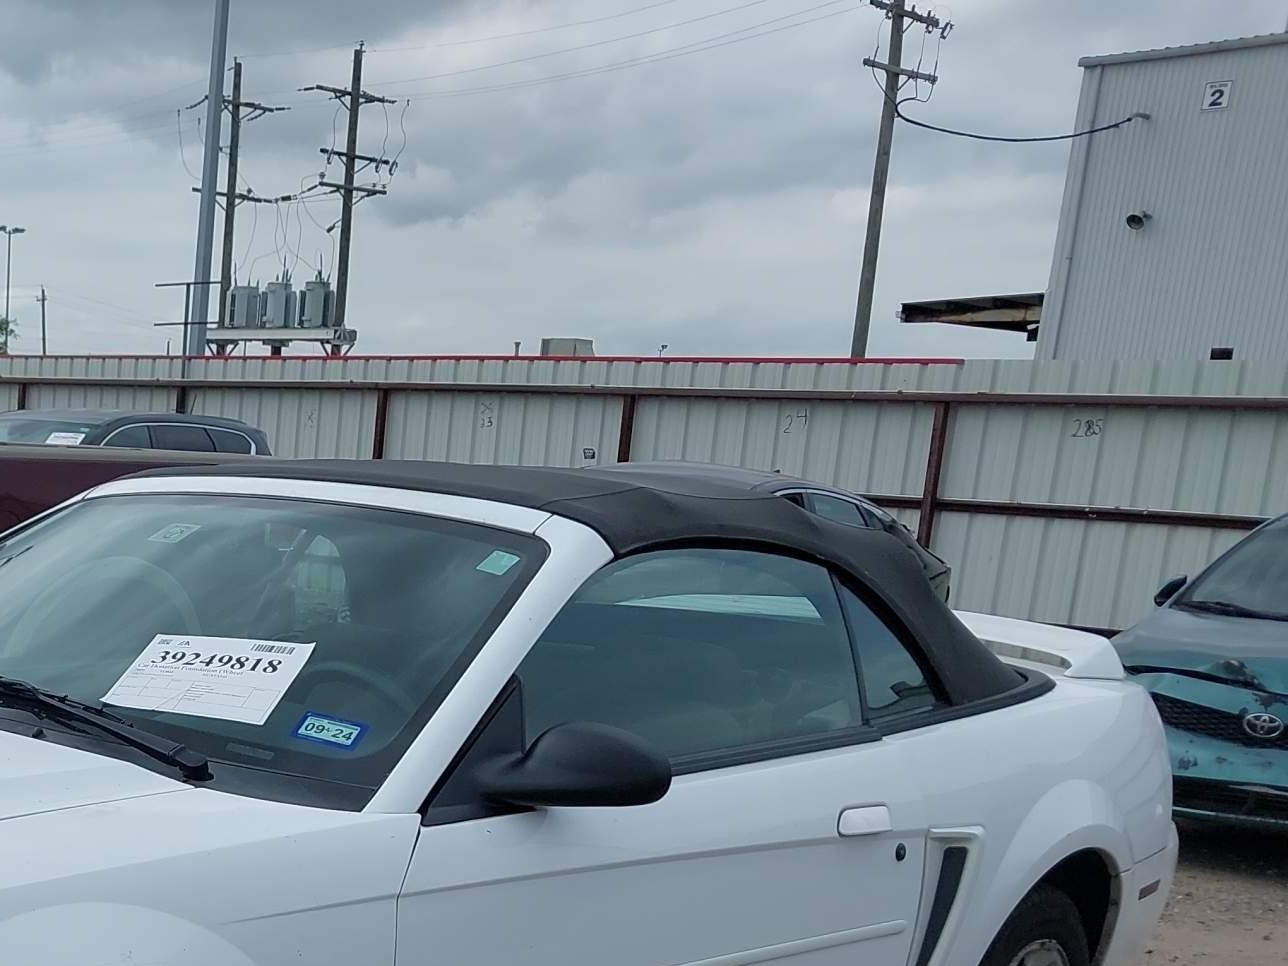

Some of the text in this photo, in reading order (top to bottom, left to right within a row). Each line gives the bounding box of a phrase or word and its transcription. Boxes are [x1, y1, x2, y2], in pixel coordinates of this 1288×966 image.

[1208, 89, 1224, 107] 2
[150, 650, 283, 674] 39249818
[305, 722, 325, 734] 09
[331, 728, 354, 741] 24
